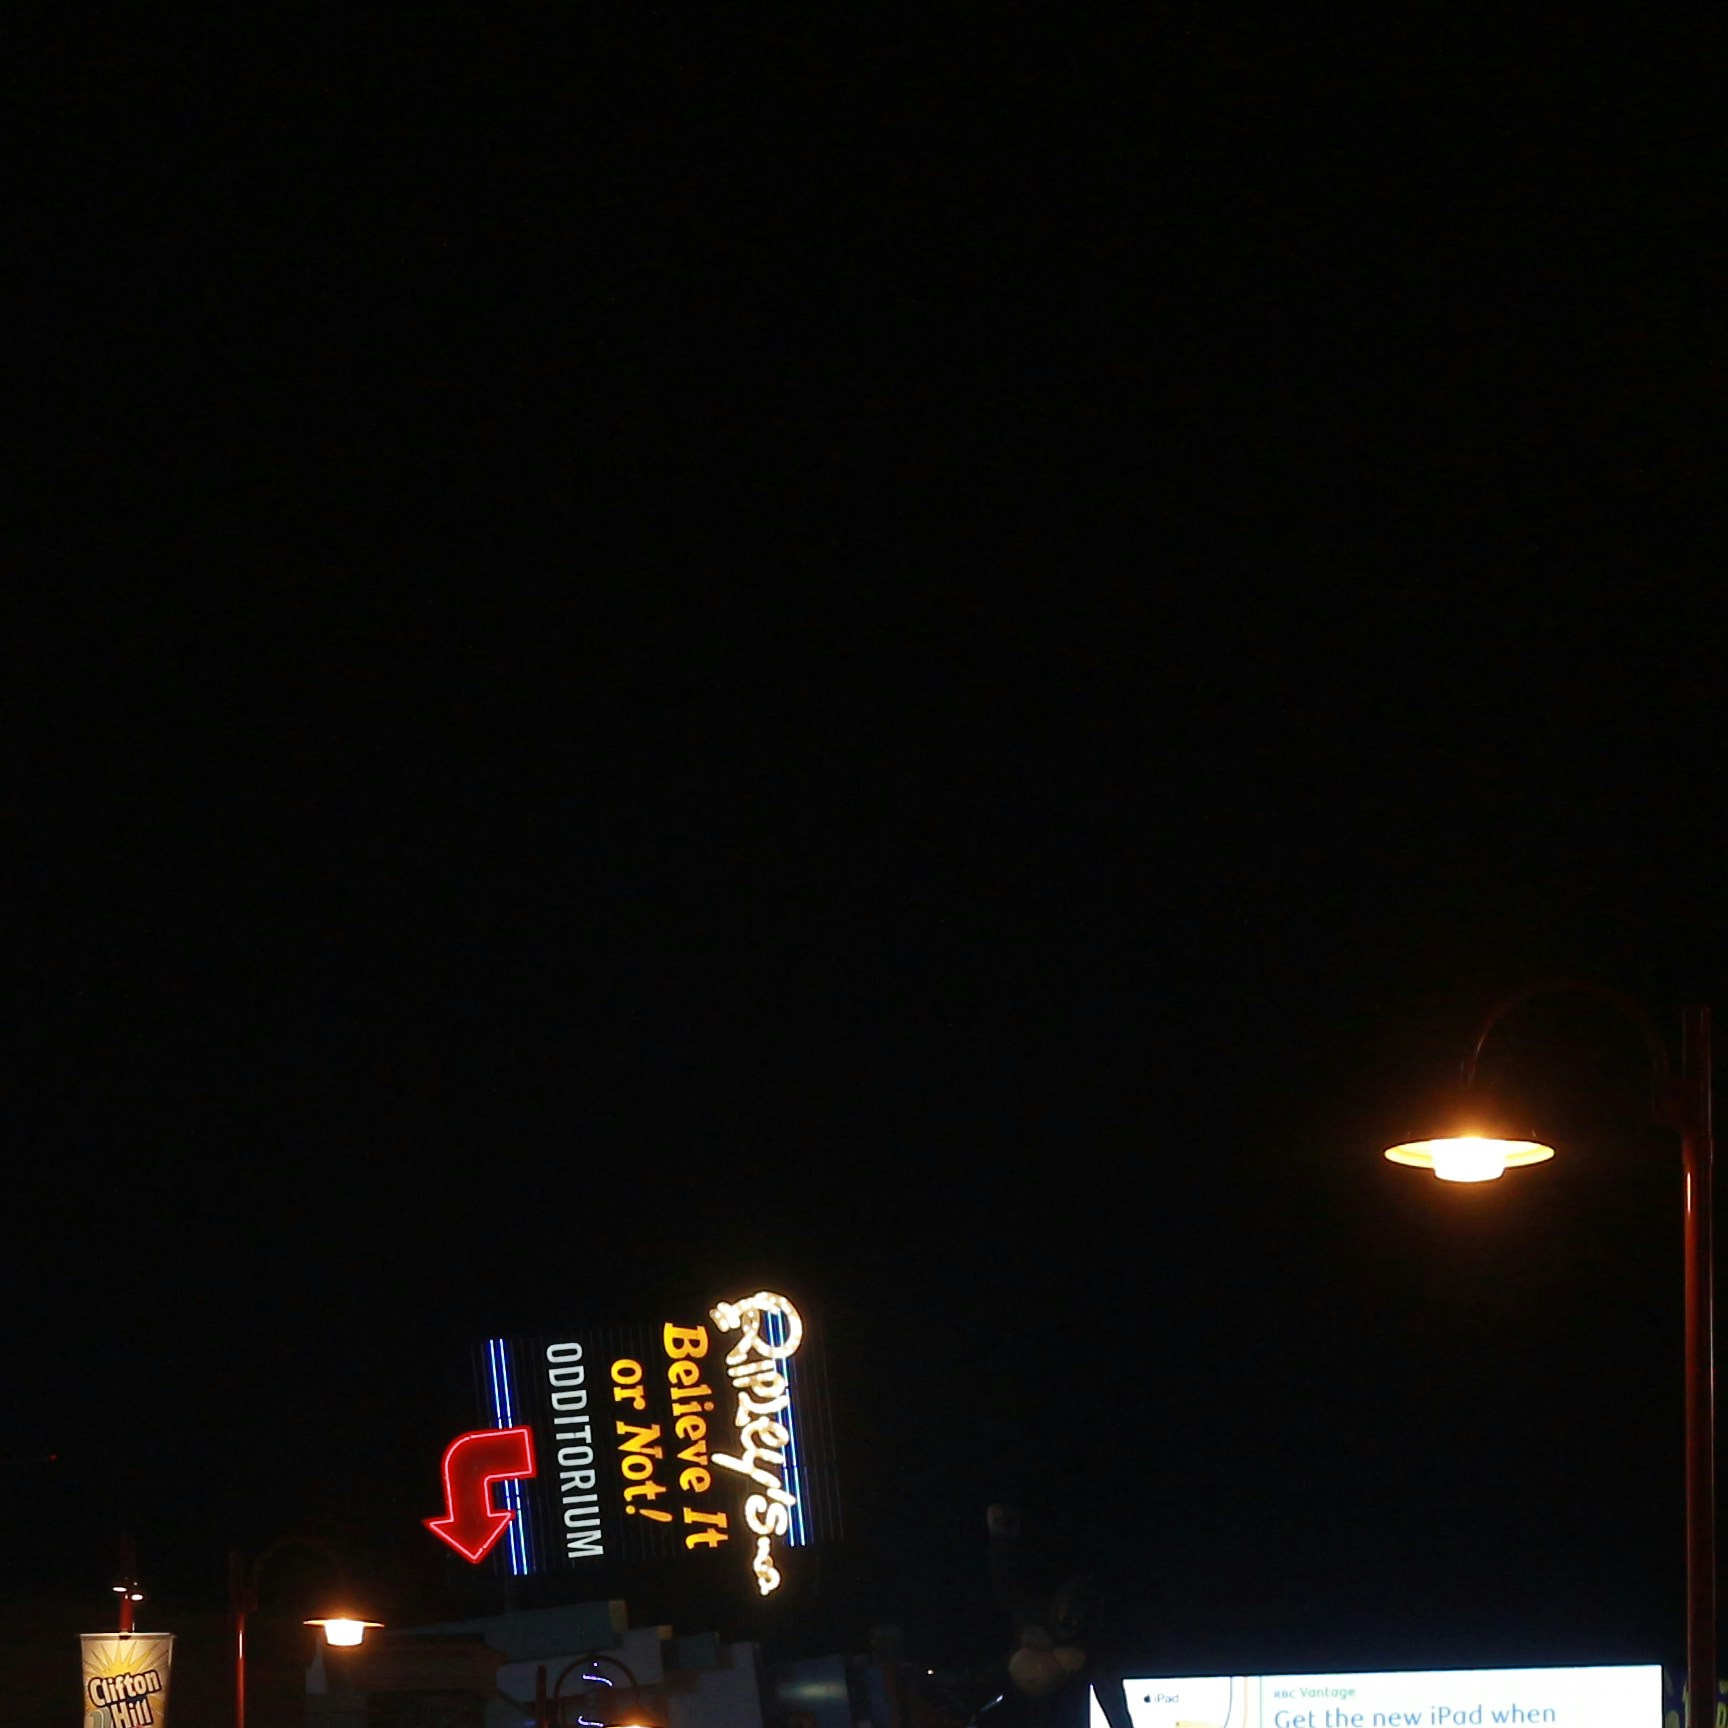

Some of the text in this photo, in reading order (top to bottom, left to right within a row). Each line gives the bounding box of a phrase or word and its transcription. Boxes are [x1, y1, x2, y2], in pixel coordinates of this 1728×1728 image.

[546, 1341, 604, 1560] ODDITORIUM
[609, 1357, 675, 1524] or Not!
[662, 1321, 730, 1550] Believe It
[708, 1290, 805, 1543] Ripley's
[87, 1668, 163, 1708] Clifton
[1153, 1693, 1180, 1703] iPad
[1273, 1687, 1357, 1700] RBC Vantage
[1370, 1710, 1425, 1728] new
[1429, 1704, 1485, 1727] iPad
[1490, 1703, 1557, 1725] when
